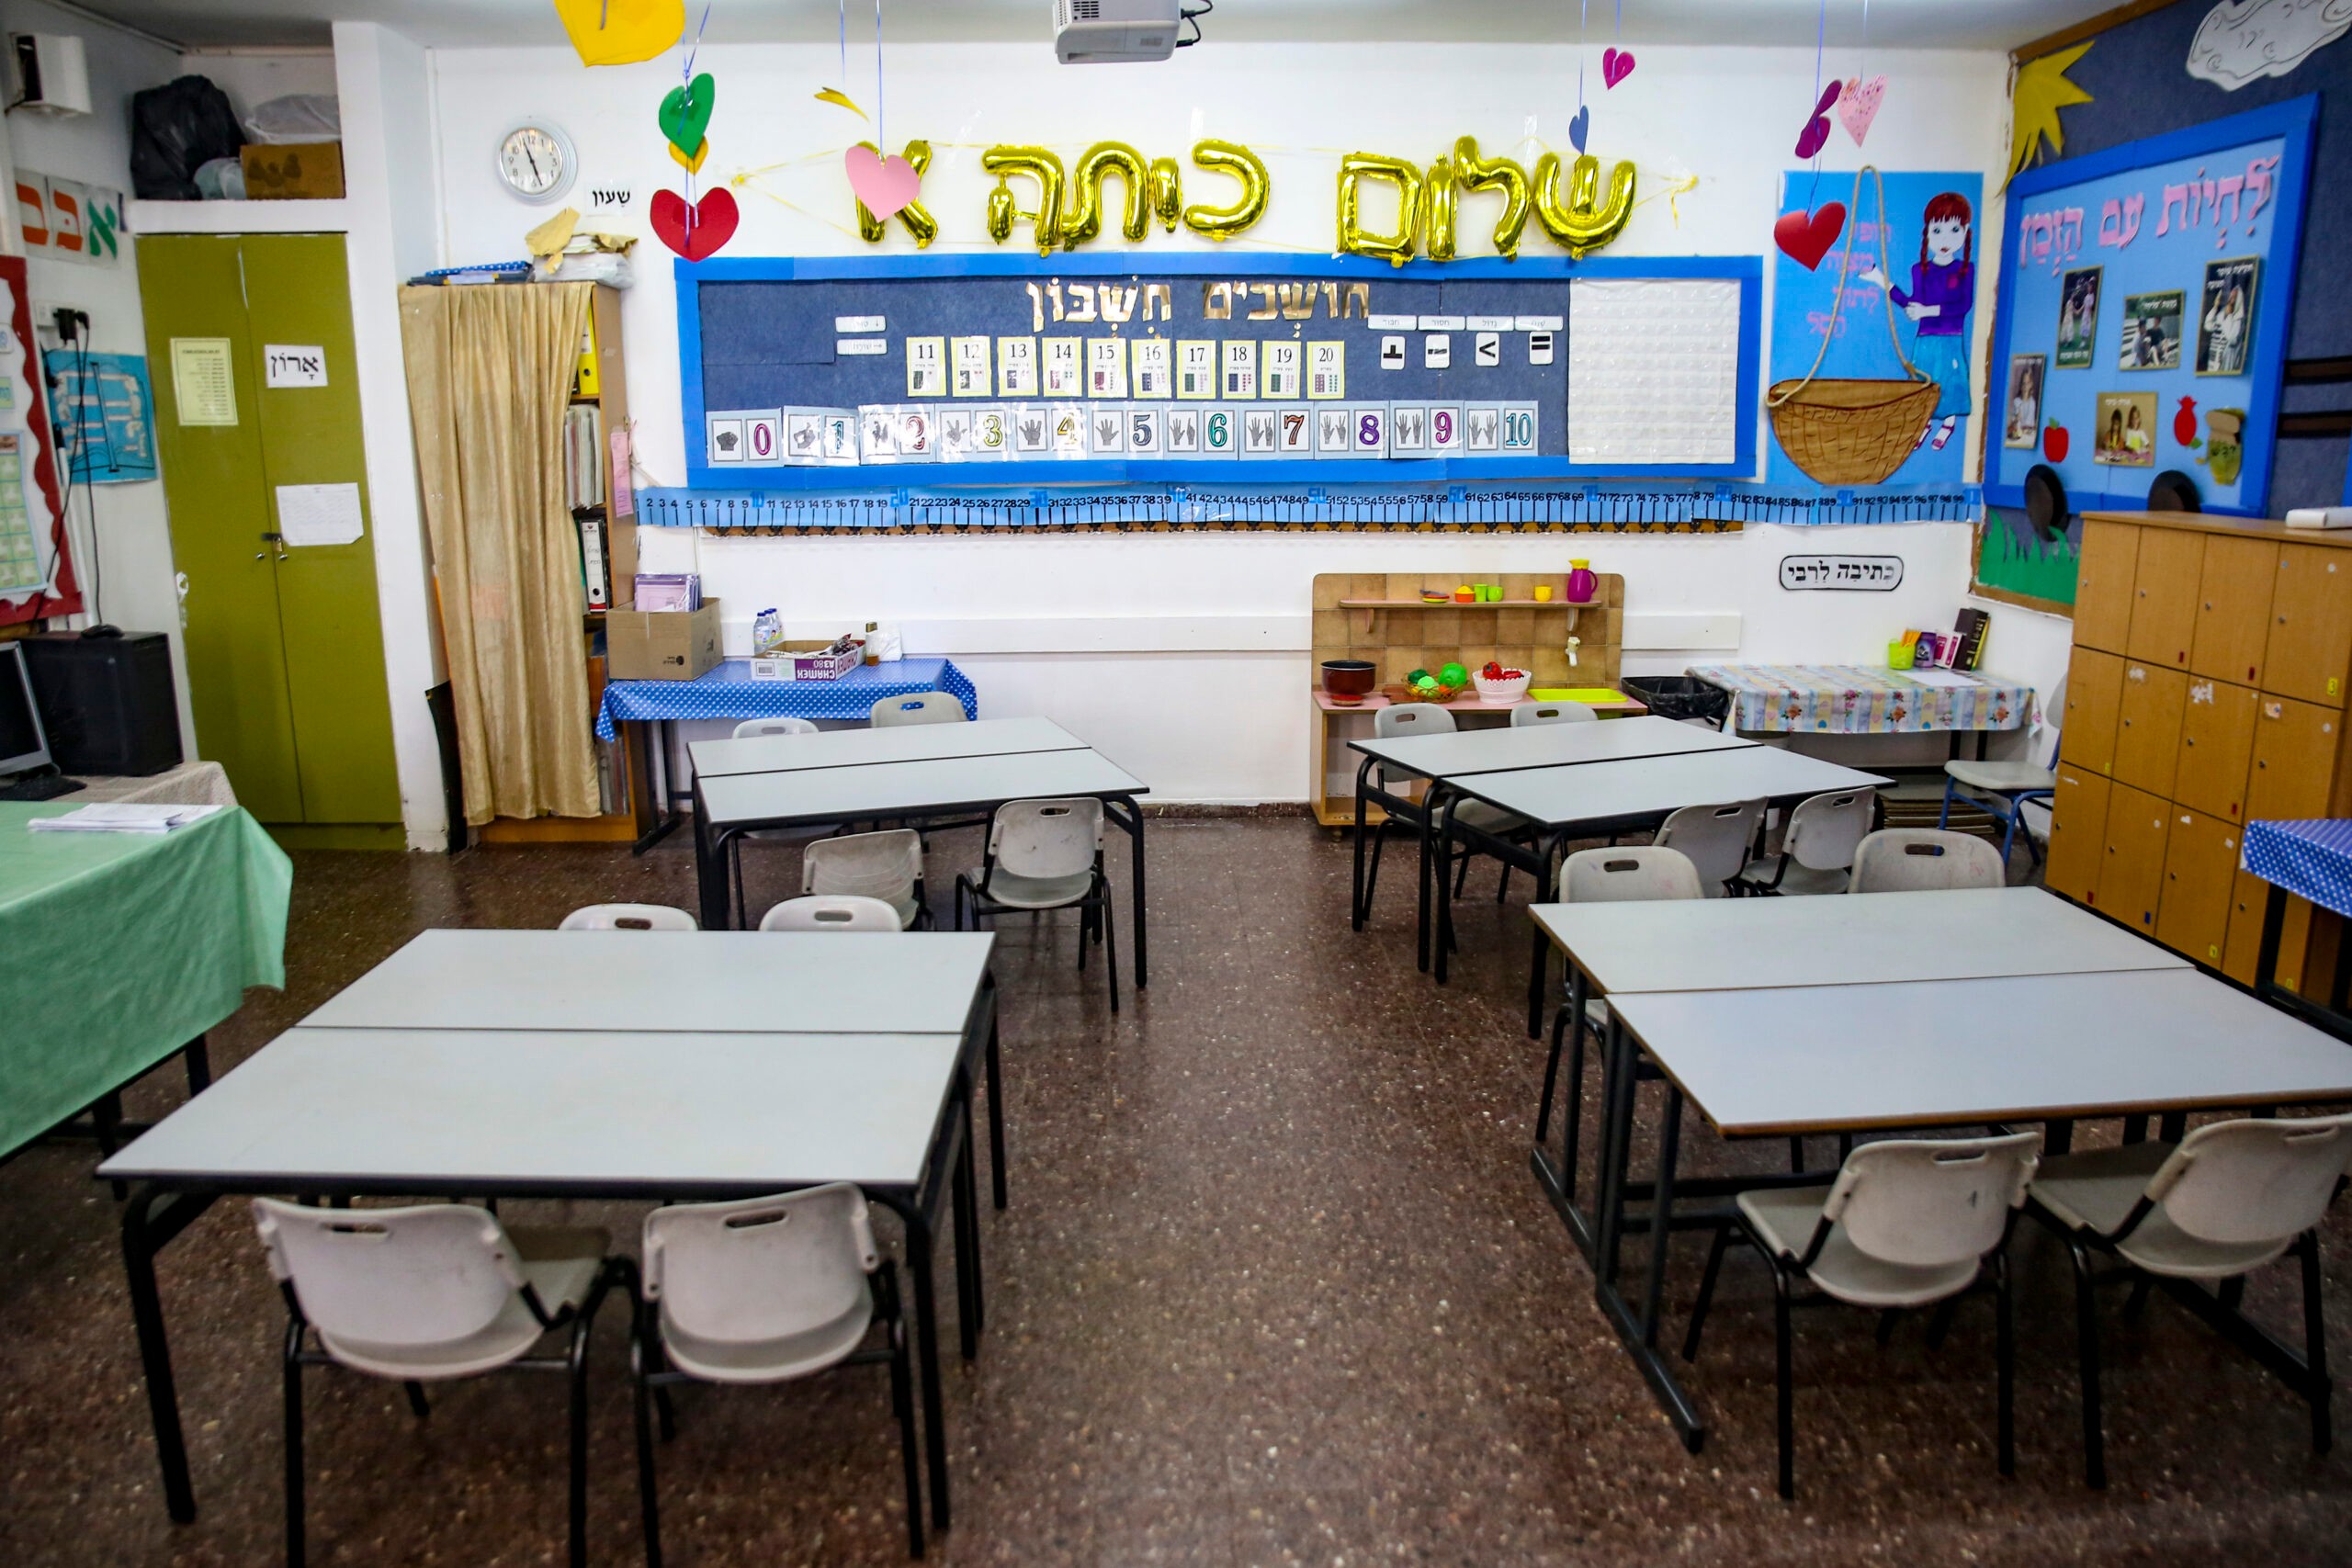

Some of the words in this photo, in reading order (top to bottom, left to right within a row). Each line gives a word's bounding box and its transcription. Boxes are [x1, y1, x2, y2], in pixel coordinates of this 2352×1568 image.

[983, 141, 1271, 257] כיתה
[1337, 136, 1635, 268] שלום
[918, 344, 933, 358] 11
[964, 344, 980, 358] 12
[1011, 344, 1027, 358] 13
[1056, 344, 1071, 358] 14
[1099, 345, 1114, 359] 15
[1146, 345, 1160, 361] 16
[1190, 347, 1204, 362] 17
[1232, 346, 1248, 361] 18
[1277, 348, 1292, 363] 19
[1319, 348, 1334, 362] 20
[753, 423, 771, 456] 0
[983, 413, 1003, 446] 3
[1132, 414, 1152, 446] 5
[1207, 412, 1228, 447] 6
[1283, 414, 1305, 446] 7
[1359, 414, 1380, 446] 8
[1434, 412, 1453, 445] 9
[1505, 412, 1533, 446] 10
[647, 499, 653, 507] 2
[660, 499, 665, 507] 3
[686, 500, 693, 508] 5
[701, 500, 707, 508] 6
[715, 500, 721, 508] 7
[729, 500, 735, 508] 8
[741, 500, 749, 508] 9
[751, 491, 764, 508] 10
[781, 501, 792, 509] 12
[794, 501, 805, 509] 13
[808, 500, 819, 509] 14
[821, 500, 832, 508] 15
[835, 500, 846, 508] 16
[849, 499, 859, 508] 17
[863, 500, 874, 508] 18
[876, 500, 888, 508] 19
[890, 488, 909, 508] 20
[910, 498, 919, 506] 21
[921, 498, 933, 507] 22
[935, 498, 947, 506] 23
[949, 498, 961, 506] 24
[964, 499, 975, 508] 25
[977, 499, 989, 508] 26
[991, 500, 1003, 508] 27
[1004, 499, 1016, 508] 28
[1017, 499, 1030, 508] 29
[1048, 499, 1059, 508] 31
[1059, 498, 1072, 506] 32
[1072, 497, 1086, 506] 33
[1087, 496, 1101, 505] 34
[1101, 496, 1114, 504] 35
[1114, 496, 1127, 504] 36
[1128, 495, 1140, 504] 37
[1143, 495, 1156, 504] 38
[1157, 495, 1171, 504] 39
[1185, 493, 1197, 502] 41
[1199, 494, 1212, 503] 42
[1213, 494, 1227, 503] 43
[1227, 495, 1240, 503] 44
[1241, 497, 1256, 505] 45
[1256, 496, 1270, 504] 46
[1270, 495, 1282, 504] 47
[1282, 495, 1295, 504] 48
[1295, 496, 1309, 504] 49
[1326, 496, 1335, 504] 51
[1336, 496, 1349, 504] 52
[1351, 496, 1363, 505] 53
[1363, 496, 1377, 505] 54
[1378, 496, 1392, 504] 55
[1393, 496, 1406, 504] 56
[1408, 494, 1419, 503] 57
[1419, 494, 1433, 503] 58
[1436, 494, 1448, 503] 59
[1464, 492, 1476, 502] 61
[1477, 494, 1489, 502] 62
[1491, 493, 1503, 502] 63
[1504, 491, 1517, 501] 64
[1518, 493, 1530, 502] 65
[1532, 493, 1544, 502] 66
[1546, 493, 1557, 502] 67
[1558, 492, 1570, 501] 68
[1572, 492, 1584, 502] 69
[1598, 493, 1607, 502] 71
[1608, 493, 1620, 502] 72
[1621, 494, 1633, 502] 73
[1635, 494, 1645, 502] 74
[1648, 494, 1659, 502] 75
[1663, 494, 1674, 502] 76
[1676, 494, 1687, 502] 77
[1688, 491, 1701, 502] 78
[1703, 492, 1714, 501] 79
[1731, 493, 1741, 502] 81
[1753, 495, 1764, 504] 83
[1778, 497, 1790, 506] 85
[1864, 497, 1875, 505] 92
[1889, 496, 1900, 504] 94
[1901, 496, 1913, 504] 95
[1914, 496, 1927, 504] 96
[1928, 495, 1939, 503] 97
[1952, 495, 1964, 504] 99
[797, 669, 835, 680] CHAMEX
